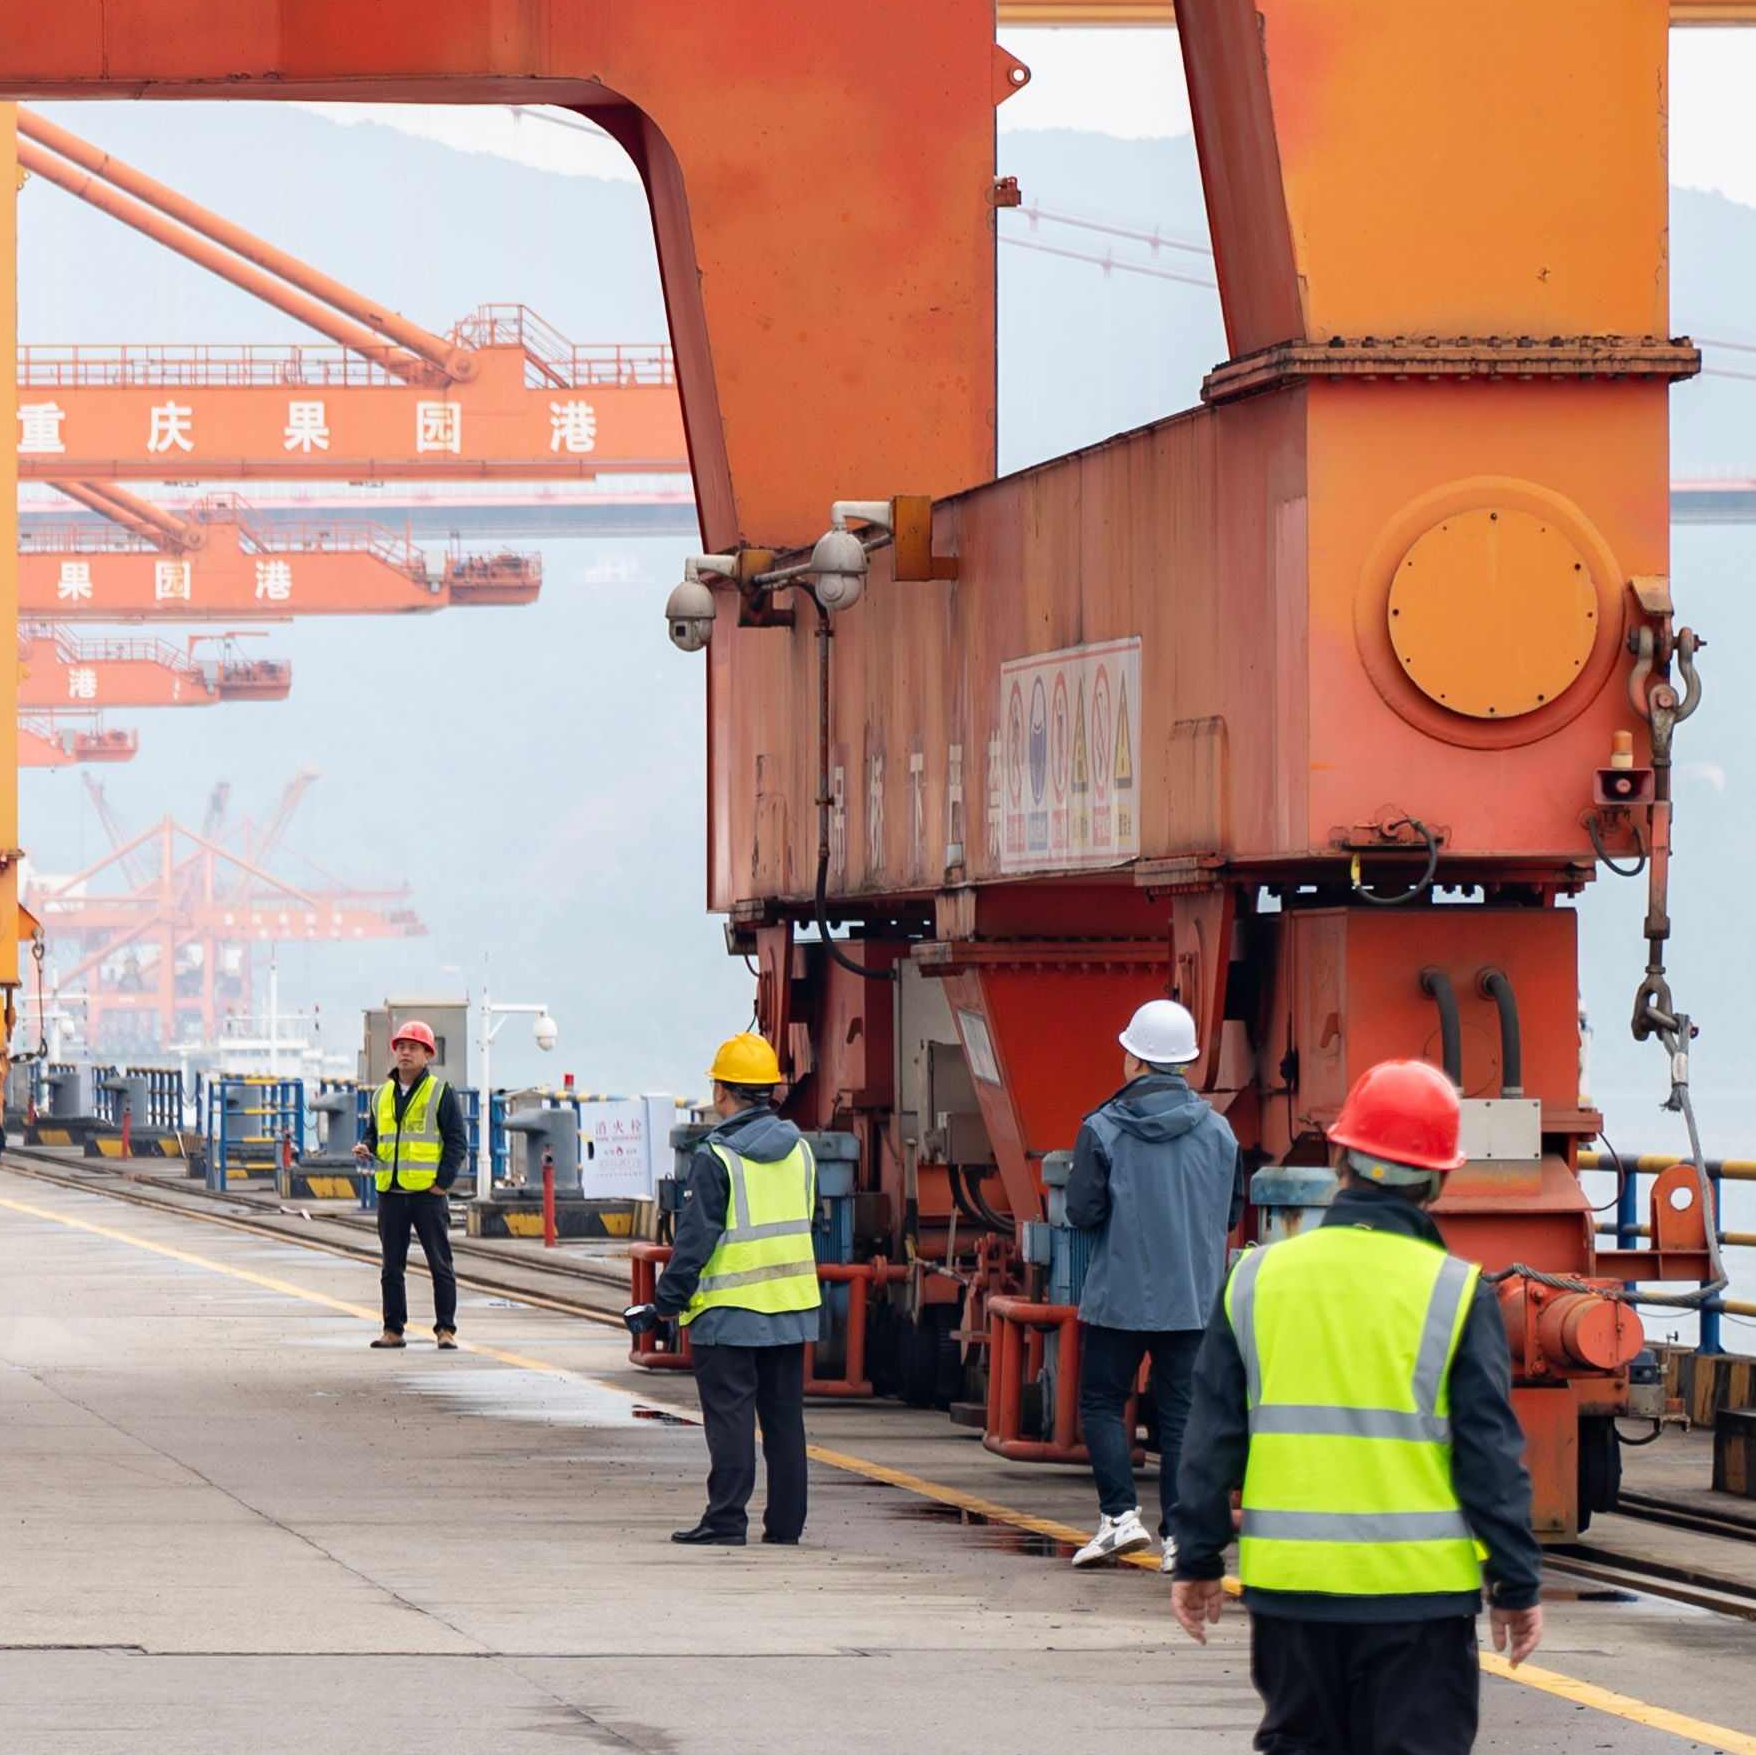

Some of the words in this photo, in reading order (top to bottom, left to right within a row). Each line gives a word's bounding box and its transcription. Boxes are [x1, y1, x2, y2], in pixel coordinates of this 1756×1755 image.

[16, 400, 598, 453] 重庆果园港
[57, 561, 292, 601] 果园港
[68, 668, 97, 700] 港
